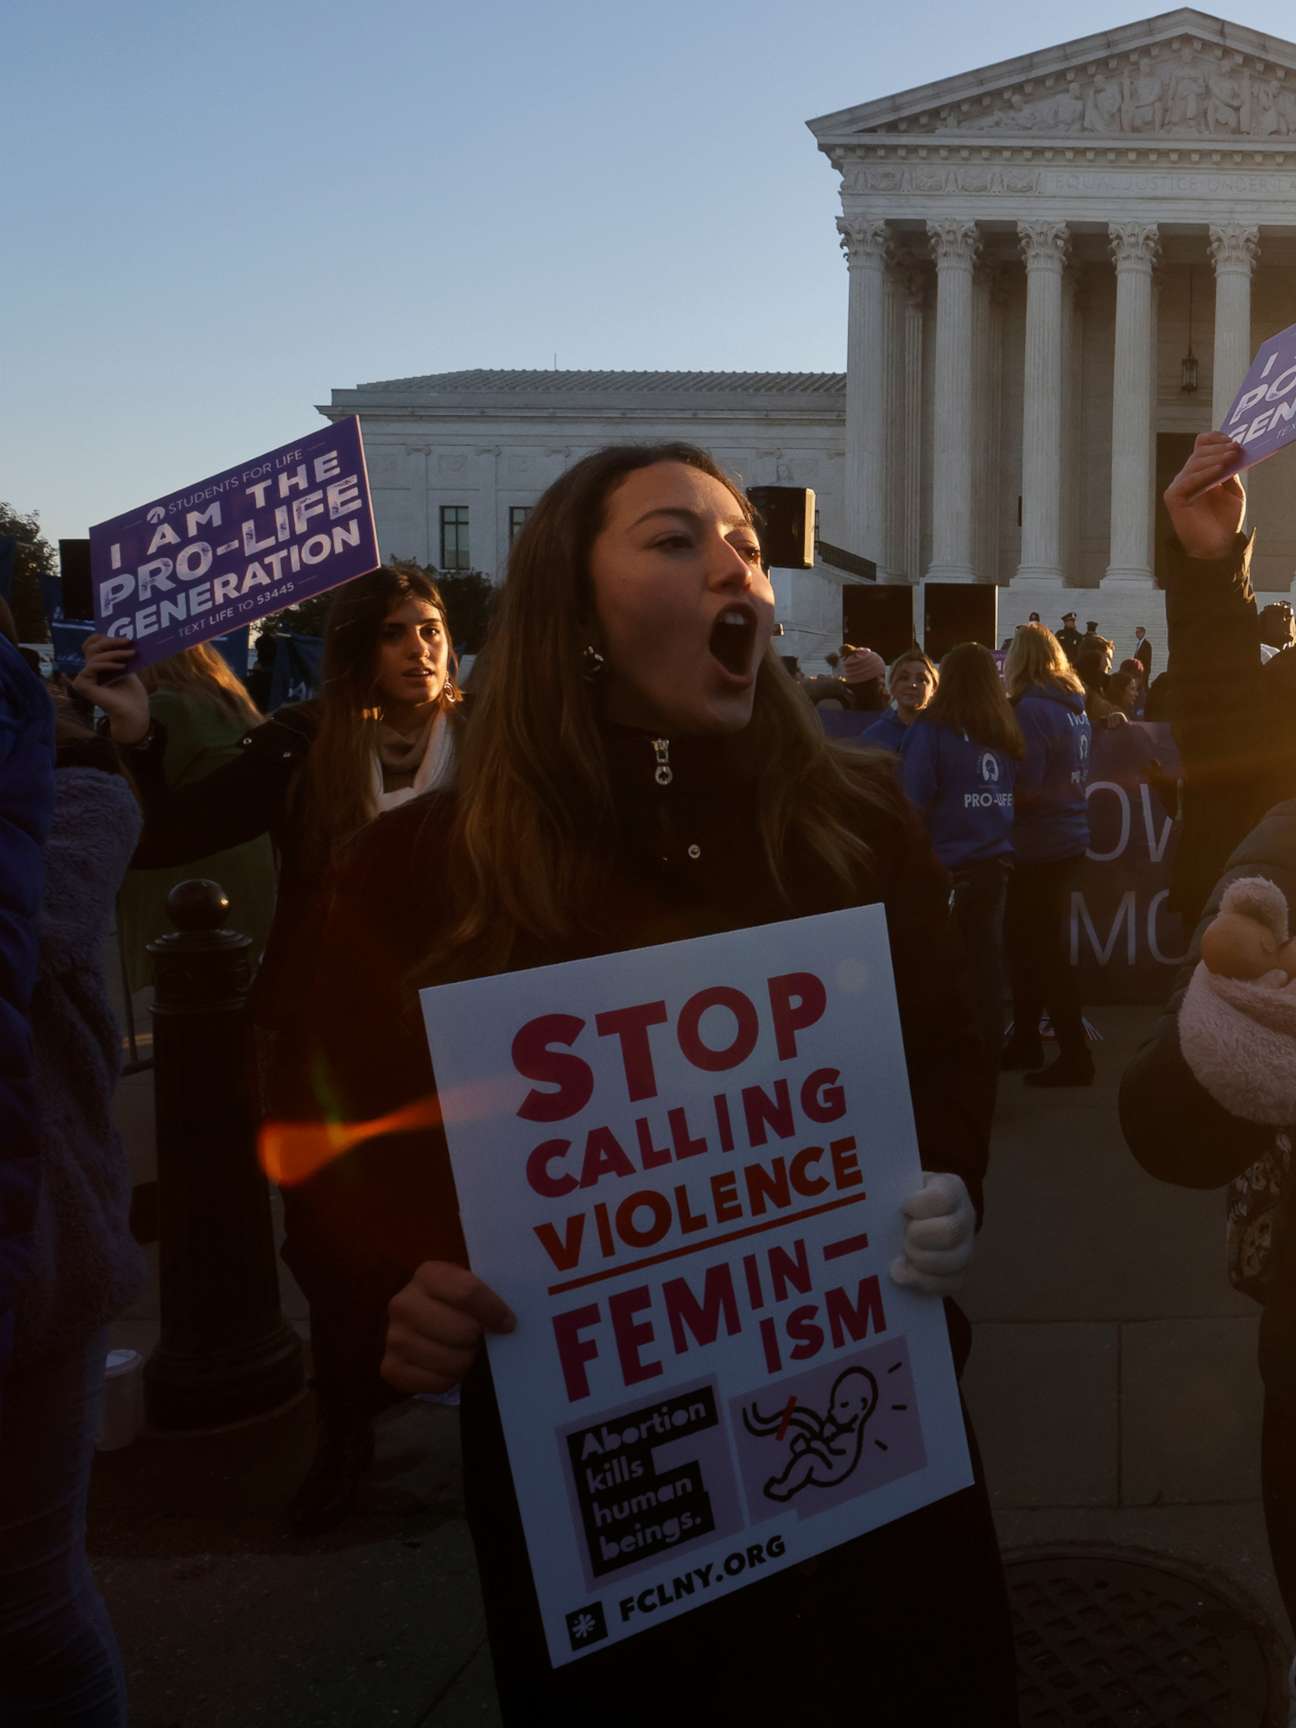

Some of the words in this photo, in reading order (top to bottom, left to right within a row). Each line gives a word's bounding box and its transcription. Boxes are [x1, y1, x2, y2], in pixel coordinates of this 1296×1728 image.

[1260, 352, 1278, 378] I
[110, 543, 121, 570] I
[146, 500, 222, 555] AM
[245, 450, 341, 510] THE
[168, 475, 240, 515] STUDENTS
[242, 462, 273, 483] FOR
[275, 448, 303, 470] LIFE
[100, 474, 363, 618] PRO-LIFE
[106, 519, 361, 642] GENERATION
[179, 619, 208, 639] TEXT
[209, 607, 234, 626] LIFE
[238, 599, 254, 613] TO
[256, 582, 295, 606] 53445
[511, 971, 827, 1122] STOP
[526, 1067, 847, 1198] CALLING
[533, 1136, 863, 1271] VIOLENCE
[552, 1233, 869, 1402] FEMIN-
[760, 1274, 887, 1374] ISM
[581, 1401, 706, 1461] Abortion
[586, 1454, 645, 1495] kills
[592, 1476, 694, 1528] human
[600, 1511, 702, 1561] beings.
[619, 1535, 786, 1622] FCLNY.ORG
